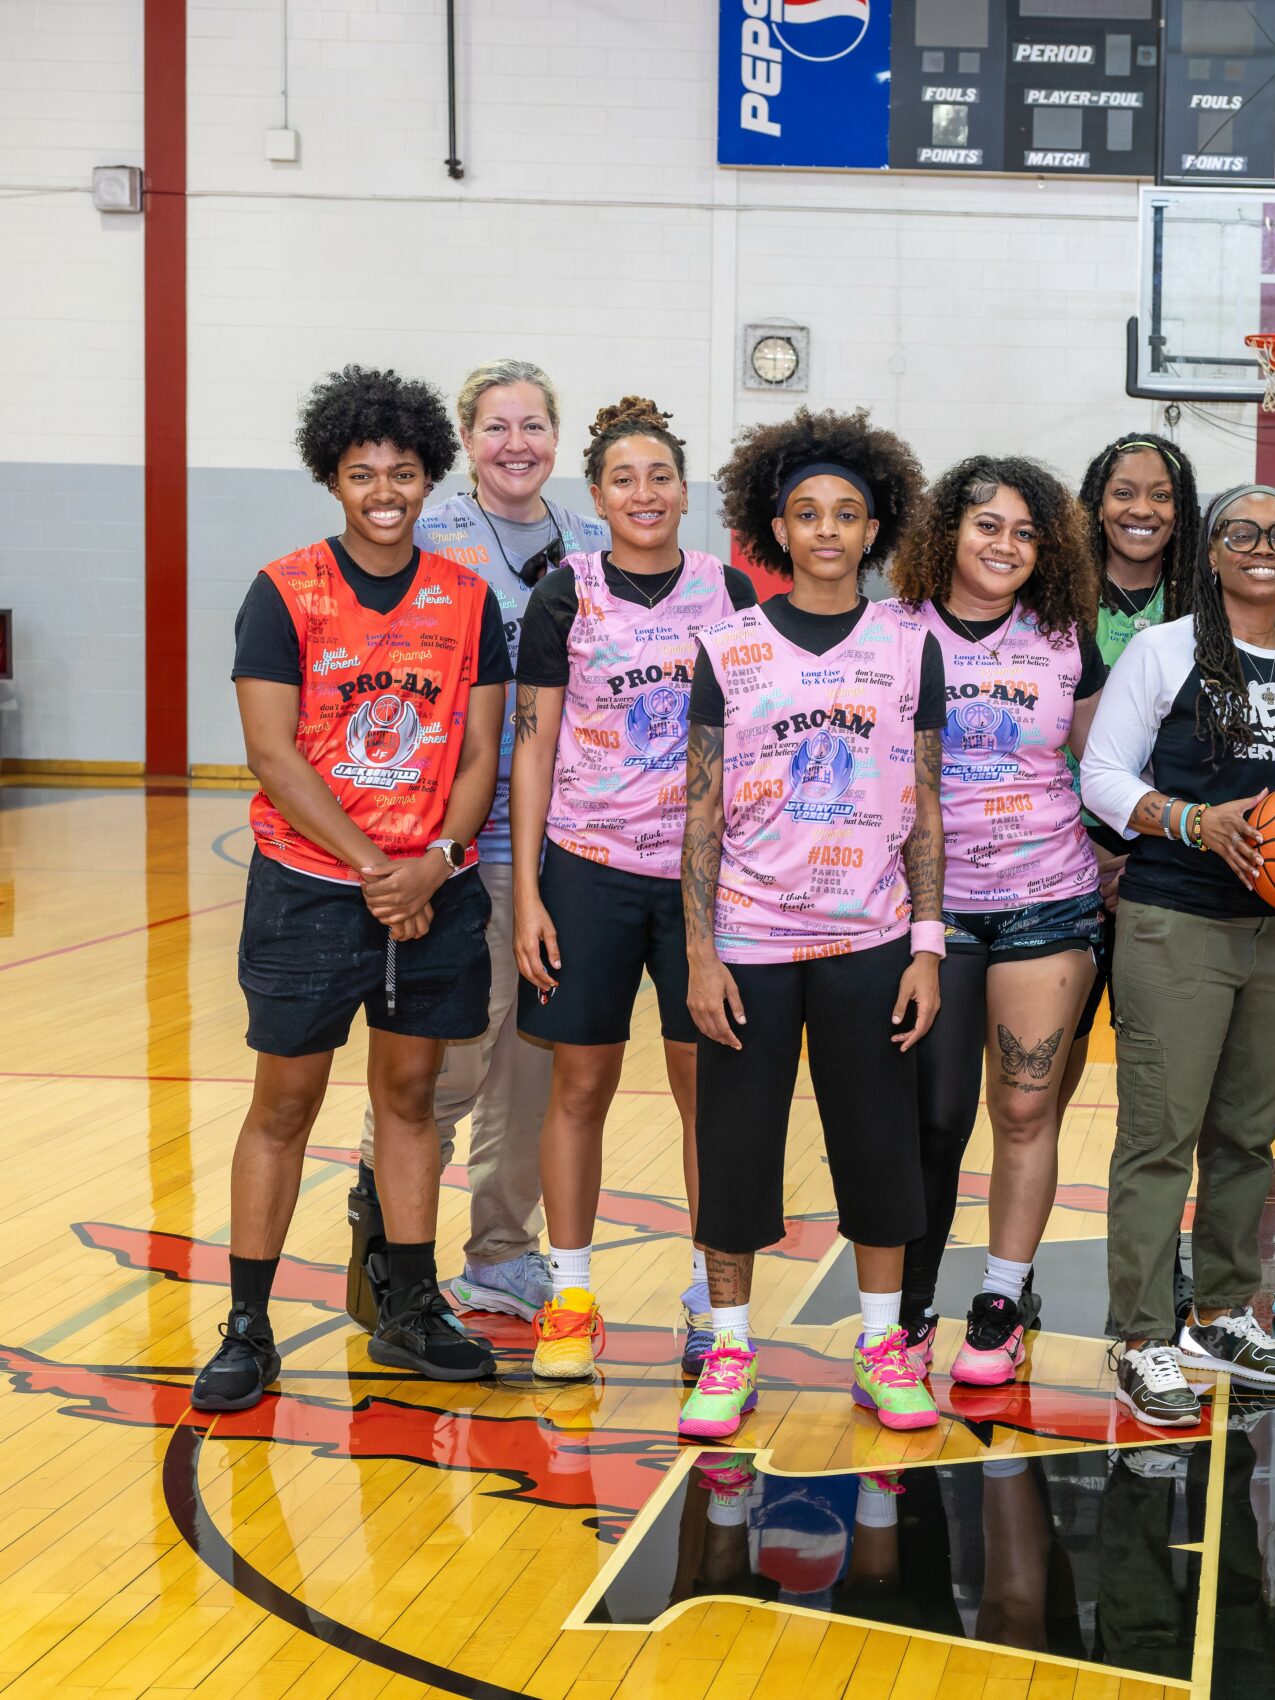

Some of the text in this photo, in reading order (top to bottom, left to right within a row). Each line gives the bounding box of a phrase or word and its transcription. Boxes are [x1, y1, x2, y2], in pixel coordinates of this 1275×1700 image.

[1014, 44, 1094, 63] PERIOD
[923, 87, 978, 103] FOULS
[1026, 90, 1142, 107] PLAYER-FOUL
[1190, 94, 1243, 110] FOULS
[919, 148, 981, 164] POINTS
[1026, 152, 1088, 168] MATCH
[1183, 155, 1245, 171] POINTS
[427, 531, 470, 545] Champs
[420, 632, 438, 641] don't
[634, 626, 673, 636] Long Live
[635, 632, 680, 644] Gy Coach
[420, 640, 435, 648] just
[323, 648, 349, 661] built
[389, 650, 433, 664] Champs
[720, 642, 774, 671] #A303
[954, 654, 976, 662] Long
[1011, 653, 1051, 663] don't worry,
[313, 655, 361, 676] different
[1026, 660, 1050, 668] believe
[801, 669, 841, 680] Long Live
[855, 669, 896, 681] don't worry,
[801, 676, 845, 686] Gy Coach
[854, 676, 893, 687] just believe
[338, 670, 442, 705] PRO-AM
[728, 686, 740, 696] BE
[771, 709, 876, 741] PRO-AM
[573, 726, 621, 750] #A303
[371, 749, 389, 760] JF
[740, 751, 755, 760] Live
[891, 746, 909, 755] Long
[889, 753, 899, 762] Gy
[335, 766, 418, 781] JACKSONVILLE
[943, 765, 1019, 776] JACKSONVILLE
[358, 776, 394, 787] FORCE
[964, 773, 998, 782] FORCE
[375, 794, 416, 808] Champs
[984, 793, 1034, 816] #A303
[843, 817, 882, 827] just believe
[862, 812, 884, 821] worry,
[636, 839, 670, 853] therefore
[807, 845, 864, 869] #A303
[970, 847, 1001, 863] therefore
[812, 868, 848, 877] FAMILY
[811, 877, 841, 885] FORCE
[1027, 871, 1066, 888] don't worry,
[821, 887, 856, 896] GREAT
[1028, 885, 1041, 895] just
[779, 902, 816, 911] therefore
